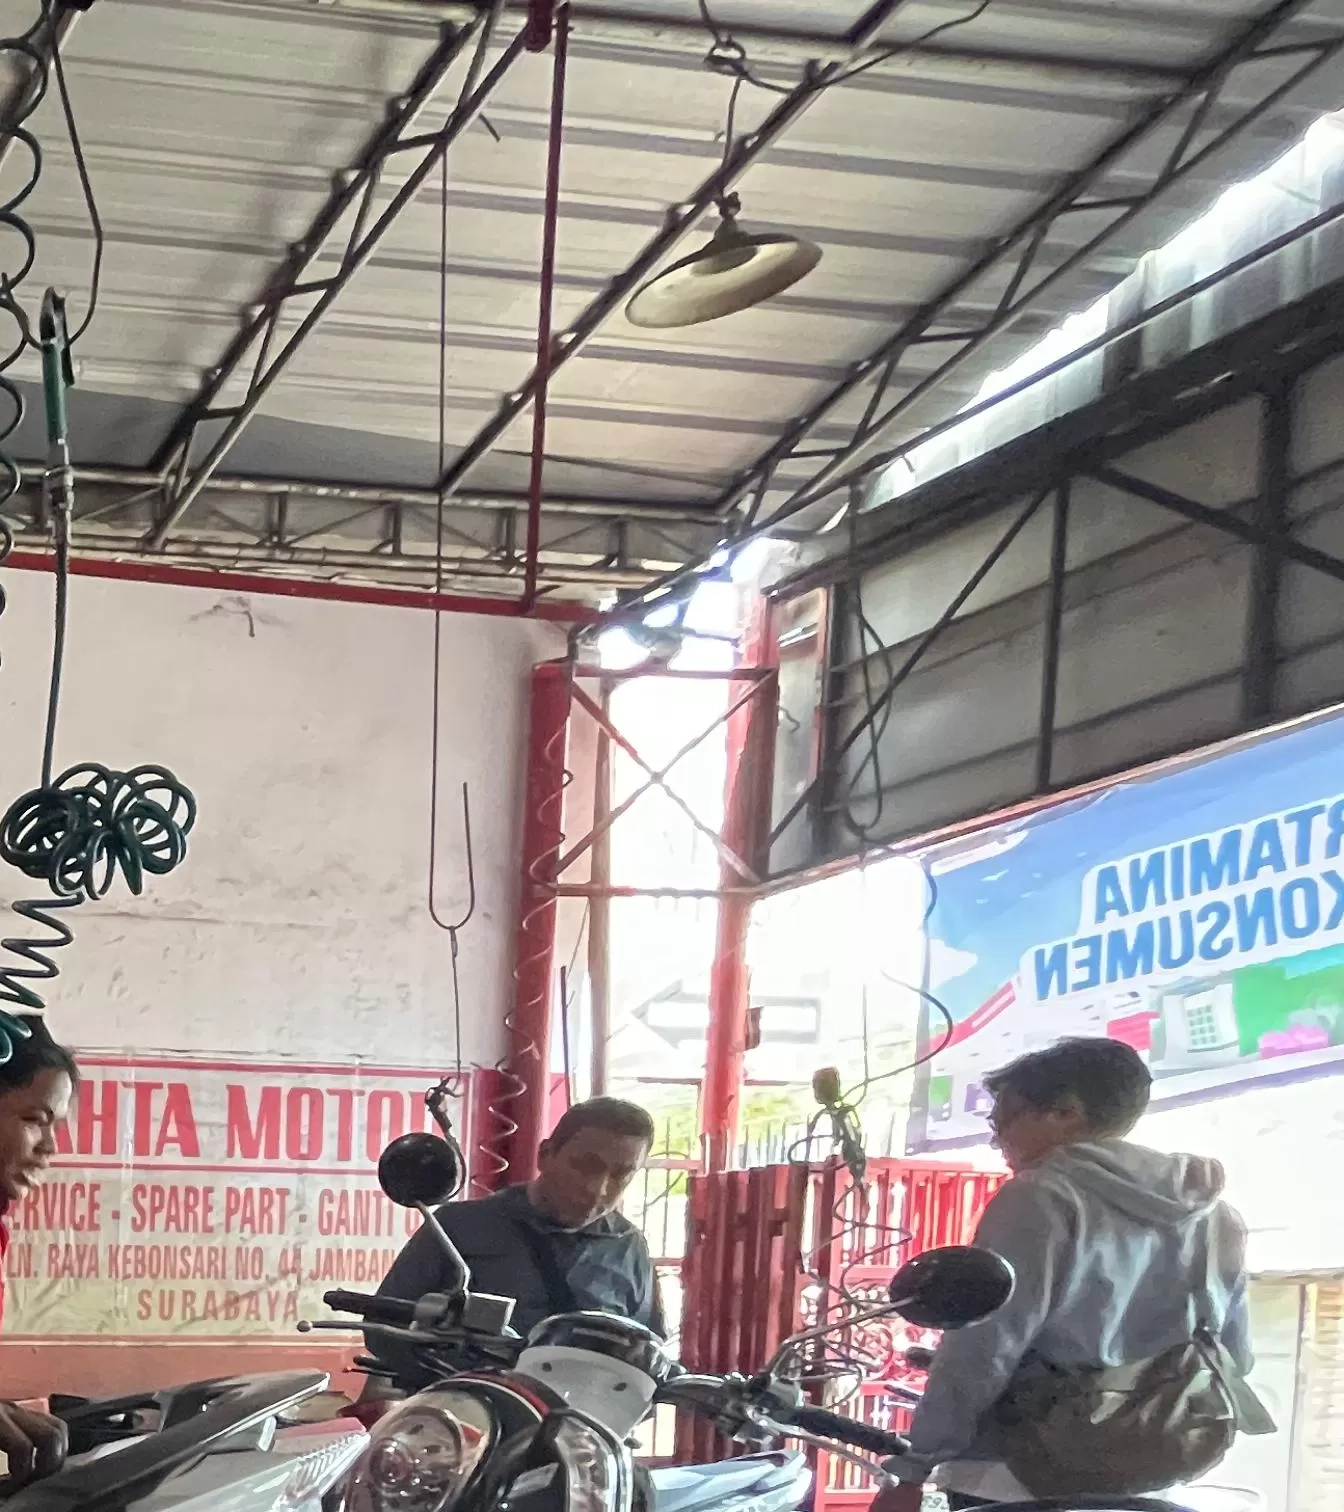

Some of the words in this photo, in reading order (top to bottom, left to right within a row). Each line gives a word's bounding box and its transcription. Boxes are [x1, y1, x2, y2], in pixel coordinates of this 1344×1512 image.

[9, 1183, 101, 1231] ERVICE
[131, 1184, 214, 1233] SPARE
[225, 1187, 290, 1235] PART
[318, 1189, 394, 1237] GANTI
[7, 1244, 38, 1279] LN.
[47, 1243, 99, 1280] RAYA
[108, 1244, 227, 1280] KEBONSARI
[137, 1289, 298, 1322] SURABAYA
